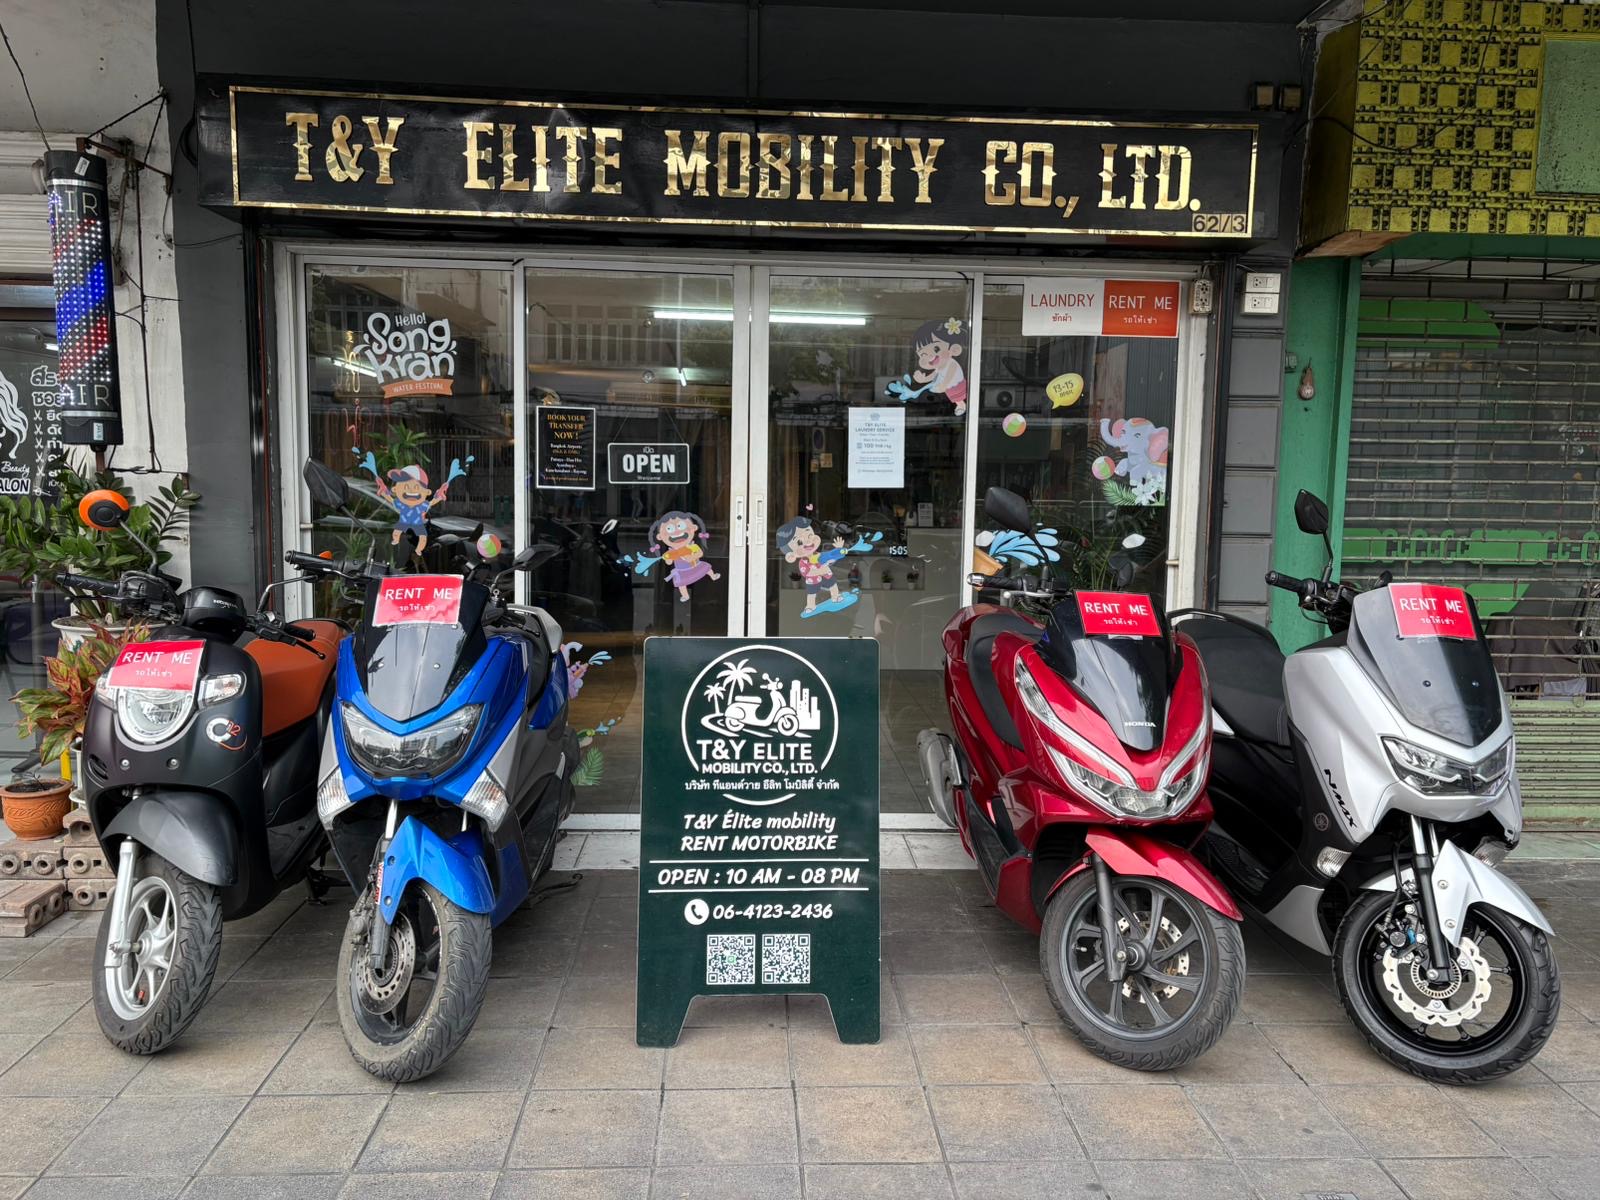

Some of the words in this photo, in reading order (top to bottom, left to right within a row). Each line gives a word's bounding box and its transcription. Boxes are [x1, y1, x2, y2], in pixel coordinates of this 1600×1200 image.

[286, 111, 405, 185] T&Y
[462, 121, 624, 195] ELITE
[663, 129, 945, 204] MOBILITY
[981, 140, 1080, 218] CO.,
[1098, 143, 1201, 212] LTD.
[1192, 214, 1246, 232] 62/3
[1030, 293, 1095, 308] LAUNDRY
[1109, 295, 1146, 310] RENT
[1154, 296, 1173, 310] ME
[394, 312, 427, 327] Hello!
[367, 312, 451, 355] Song
[393, 383, 414, 393] WATER
[415, 382, 444, 391] FESTIVAL
[1053, 380, 1074, 394] 13-15
[549, 422, 584, 430] TRANSFER
[554, 431, 573, 439] NOW
[1, 461, 30, 478] Beauty
[622, 454, 675, 473] OPEN
[385, 588, 425, 600] RENT
[433, 587, 453, 600] ME
[1084, 602, 1120, 614] RENT
[1128, 604, 1149, 616] ME
[1400, 598, 1437, 611] RENT
[1444, 599, 1464, 613] ME
[122, 651, 164, 663] RENT
[171, 652, 193, 665] ME
[696, 739, 747, 761] T&Y
[753, 743, 812, 761] ELITE
[702, 762, 763, 774] MOBILITY
[762, 762, 789, 776] CO.,
[791, 762, 818, 774] LTD.
[684, 779, 710, 791] บริษัท
[816, 778, 840, 790] จำกัด
[1324, 769, 1357, 828] NMAX
[683, 814, 718, 830] T&Y
[722, 809, 763, 829] Élite
[766, 811, 836, 833] mobility
[680, 836, 729, 851] RENT
[731, 835, 838, 851] MOTORBIKE
[657, 868, 710, 885] OPEN
[726, 868, 748, 884] 10
[751, 868, 782, 885] AM
[801, 868, 826, 884] 08
[830, 867, 860, 884] PM
[712, 903, 834, 920] 06-4123-2436
